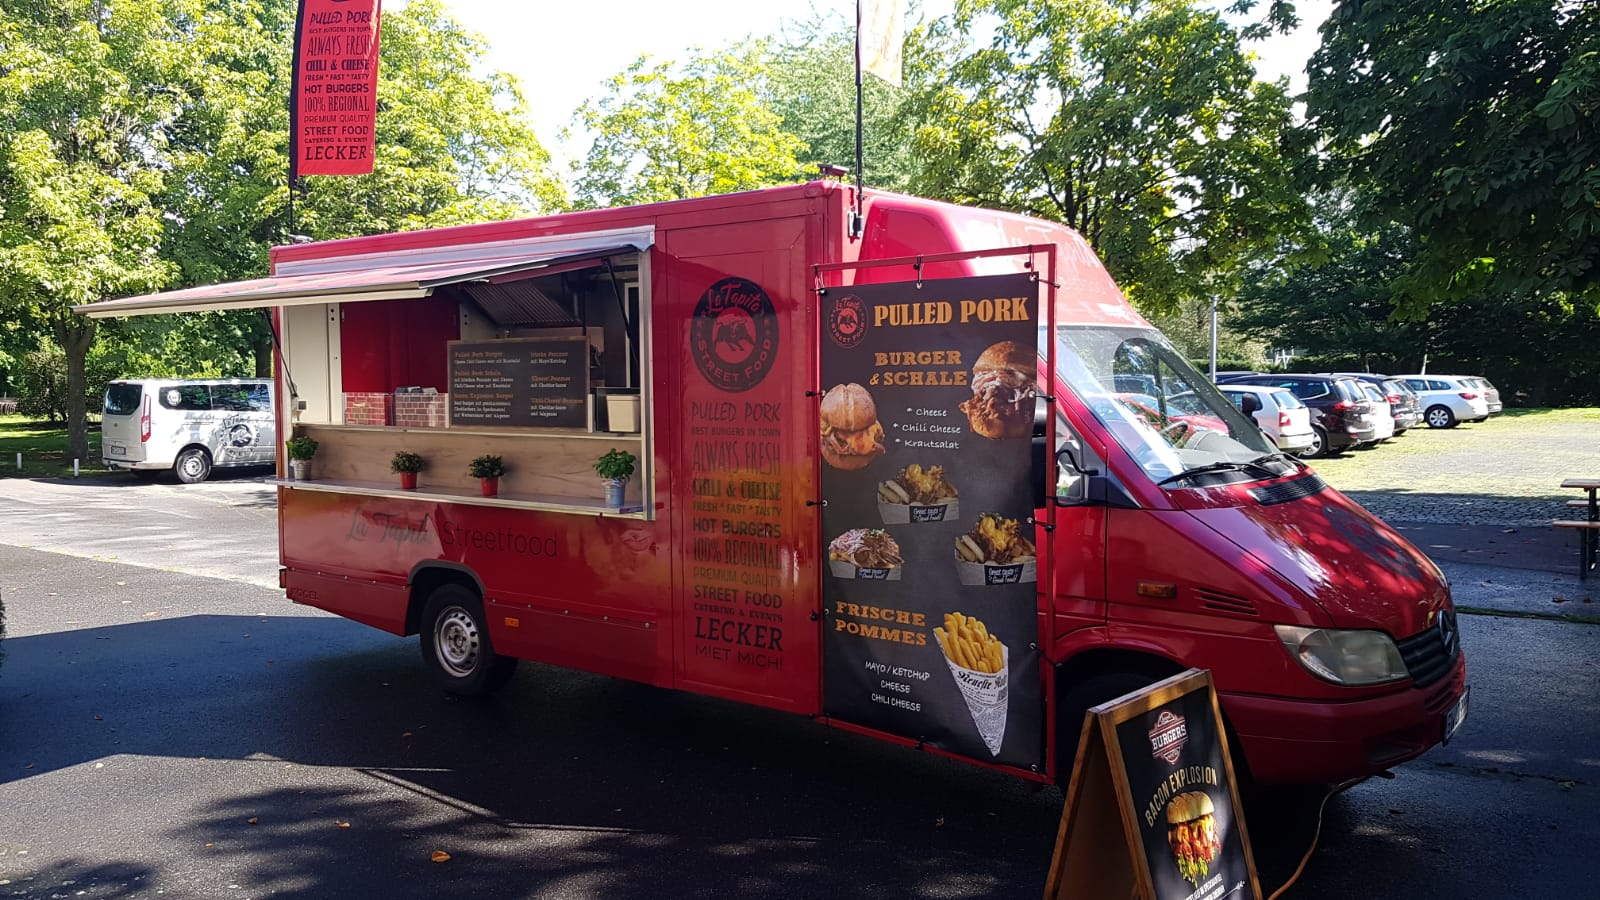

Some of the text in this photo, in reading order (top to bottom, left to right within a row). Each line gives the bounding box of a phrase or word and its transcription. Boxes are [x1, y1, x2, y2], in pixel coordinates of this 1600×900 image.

[310, 11, 342, 25] PULLED
[306, 35, 342, 56] ALWAYS
[306, 59, 370, 72] CHILI & CHEESE
[304, 84, 369, 94] HOT BURGERS
[304, 96, 370, 112] 100% REGIONAL
[304, 114, 370, 123] PREMIUM QUALITY
[304, 126, 368, 136] STREET FOOD
[306, 146, 366, 160] LECKER
[873, 297, 1030, 327] PULLED PORK
[698, 340, 770, 382] STREET FOOD
[874, 350, 962, 366] BURGER
[870, 371, 968, 386] & SCHALE
[692, 402, 782, 422] PULLED PORK
[916, 408, 947, 417] Cheese
[902, 424, 961, 434] Chili Cheese
[904, 440, 960, 450] Krautsalat
[693, 441, 782, 476] ALWAYS FRESH
[693, 478, 782, 500] CHILI & CHEESE
[693, 518, 782, 538] HOT BURGERS
[443, 520, 558, 558] Streetfood
[725, 540, 782, 570] REGIONAL
[694, 585, 782, 608] STREET FOOD
[836, 601, 926, 626] FRISCHE
[696, 616, 783, 652] LECKER
[834, 619, 928, 646] POMMES
[696, 645, 731, 660] MIET
[880, 680, 910, 694] CHEESE
[871, 693, 921, 712] CHILI CHEESE
[1152, 724, 1186, 750] BURGERS
[1144, 766, 1218, 828] BACON EXPLOSION
